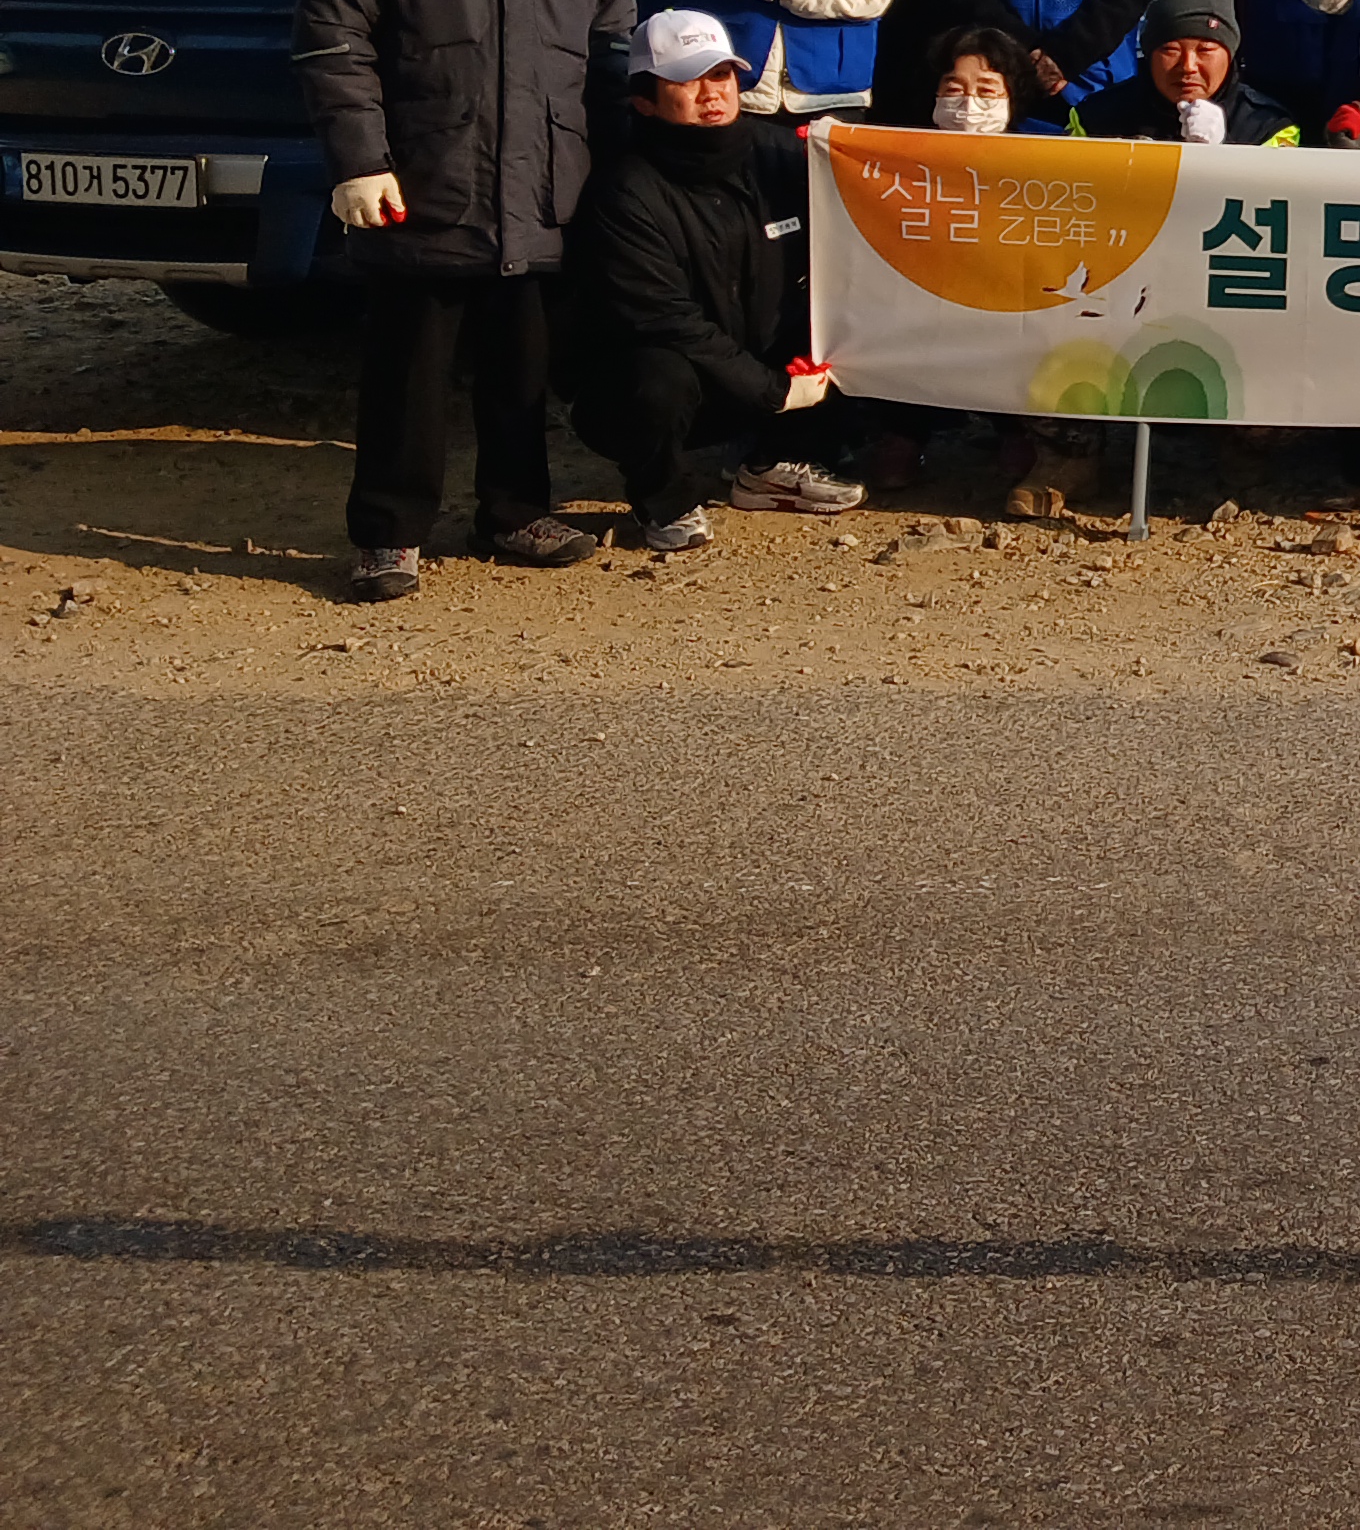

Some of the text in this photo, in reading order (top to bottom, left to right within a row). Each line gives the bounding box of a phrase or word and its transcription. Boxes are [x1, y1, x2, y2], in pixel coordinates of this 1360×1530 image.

[25, 159, 189, 201] 810거 5377
[1000, 178, 1097, 211] 2025
[1201, 198, 1289, 311] 설
